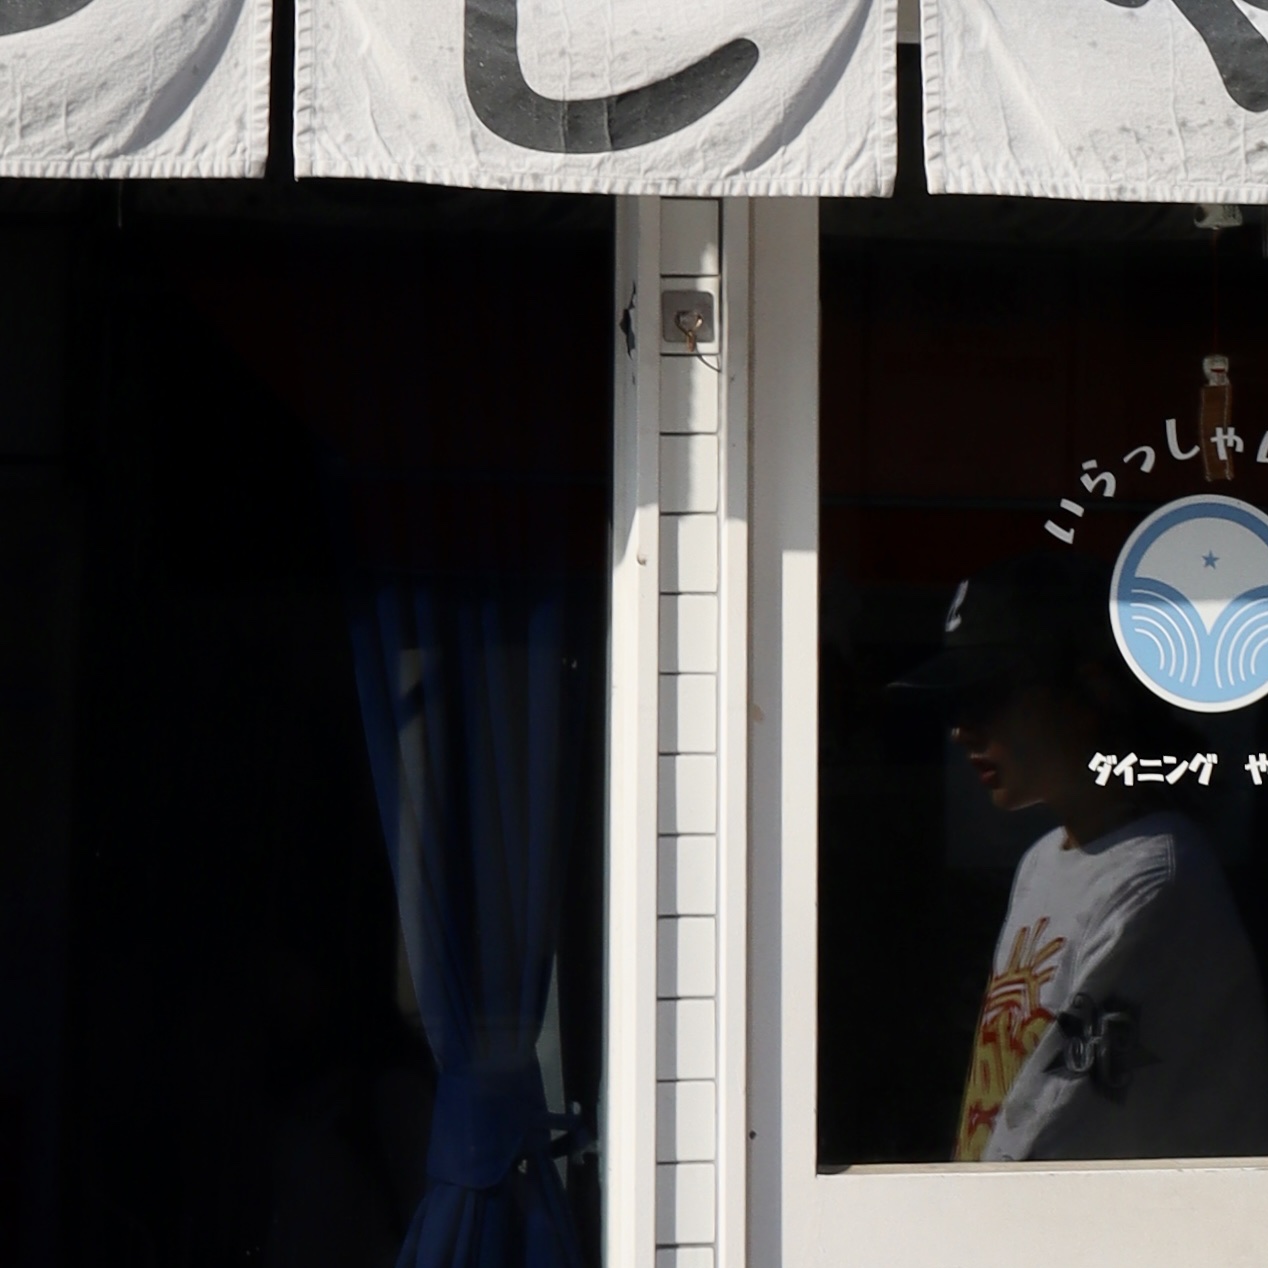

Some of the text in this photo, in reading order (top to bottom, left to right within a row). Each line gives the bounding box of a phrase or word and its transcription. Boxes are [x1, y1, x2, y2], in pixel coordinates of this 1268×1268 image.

[1088, 752, 1218, 787] ダイニング
